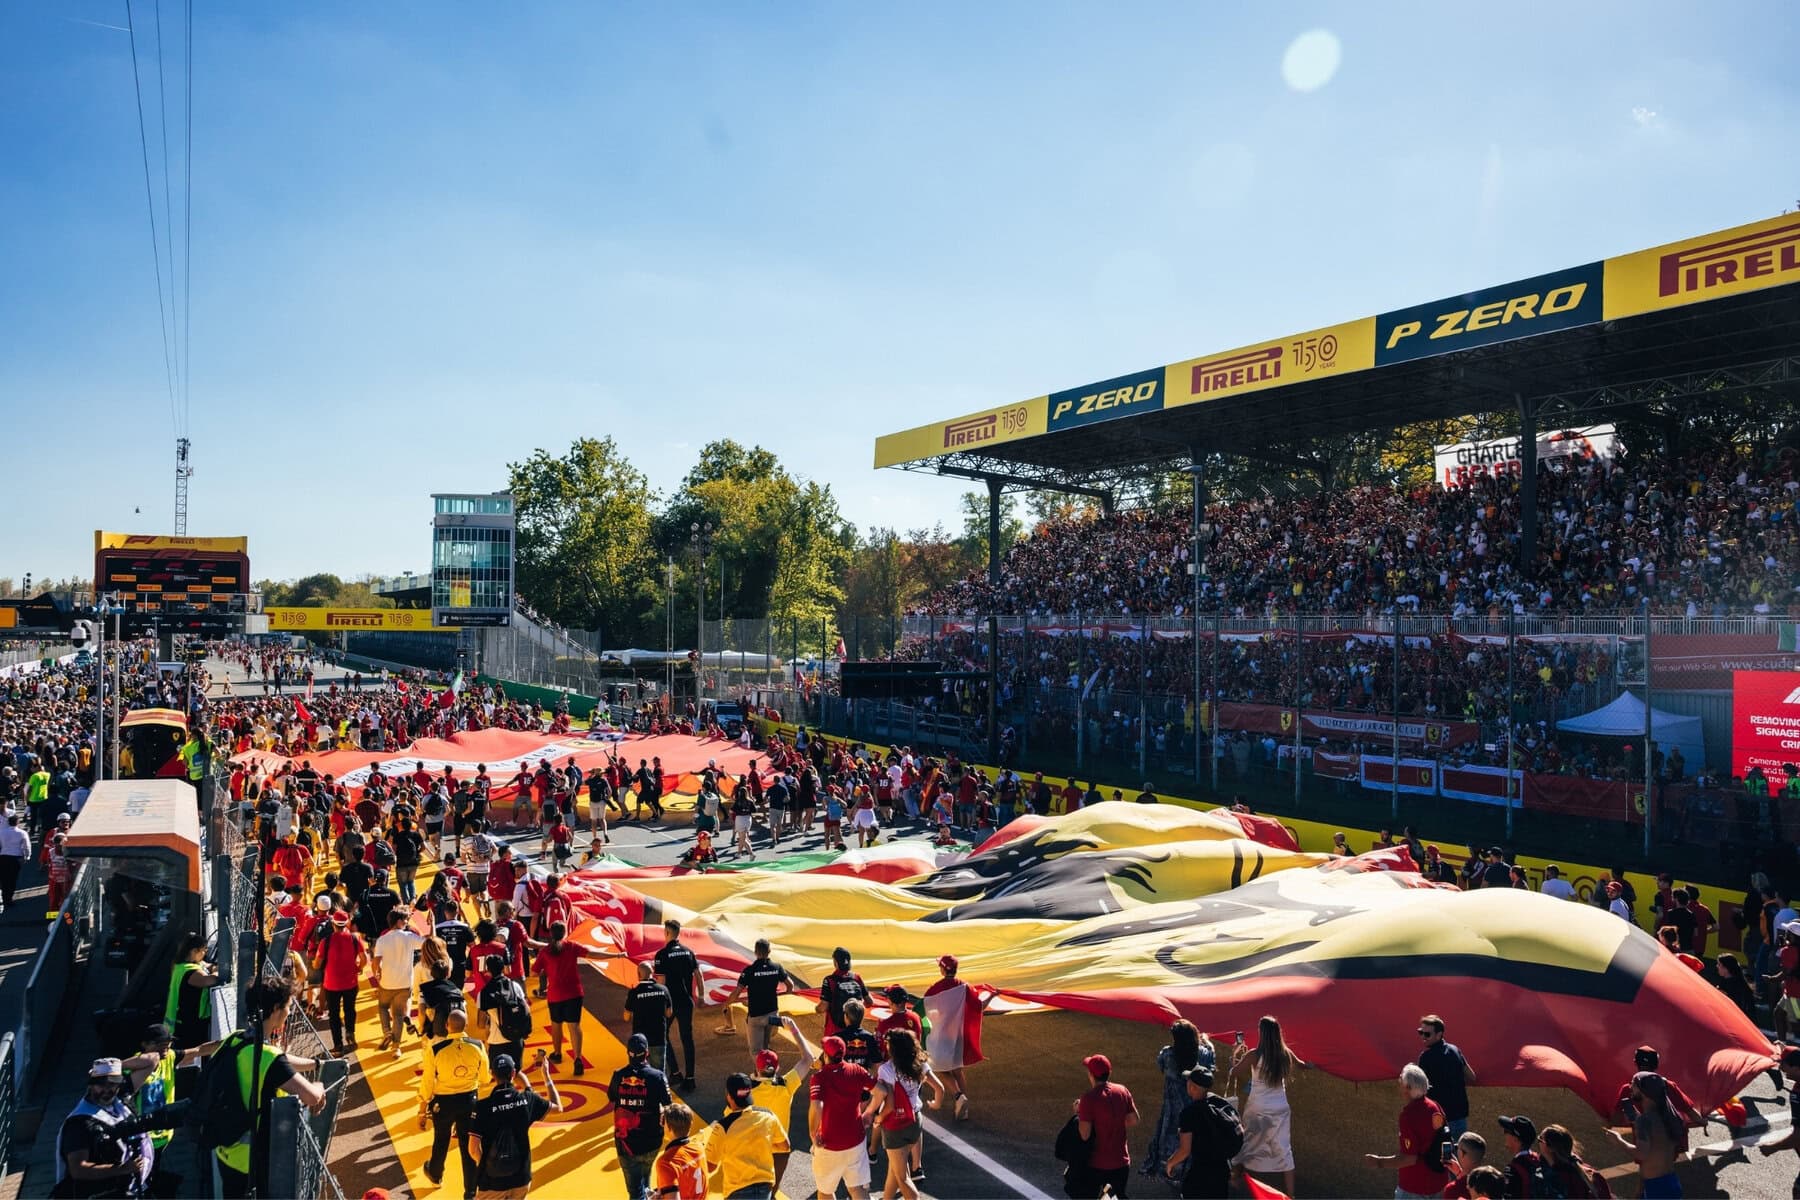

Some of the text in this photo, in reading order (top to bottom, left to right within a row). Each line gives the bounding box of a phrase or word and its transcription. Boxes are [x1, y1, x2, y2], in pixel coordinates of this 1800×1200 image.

[1386, 283, 1588, 349] P ZERO
[1191, 335, 1338, 395] PIRELLI 150
[1053, 381, 1157, 420] P ZERO
[944, 407, 1028, 448] PIRELLI 150
[1457, 442, 1522, 465] CHARLE
[281, 612, 307, 626] 150
[326, 613, 383, 626] PIRELLI
[388, 613, 414, 626] 150
[1756, 727, 1800, 738] SIGNAGE
[1748, 757, 1781, 767] Cameras
[1768, 776, 1782, 784] the
